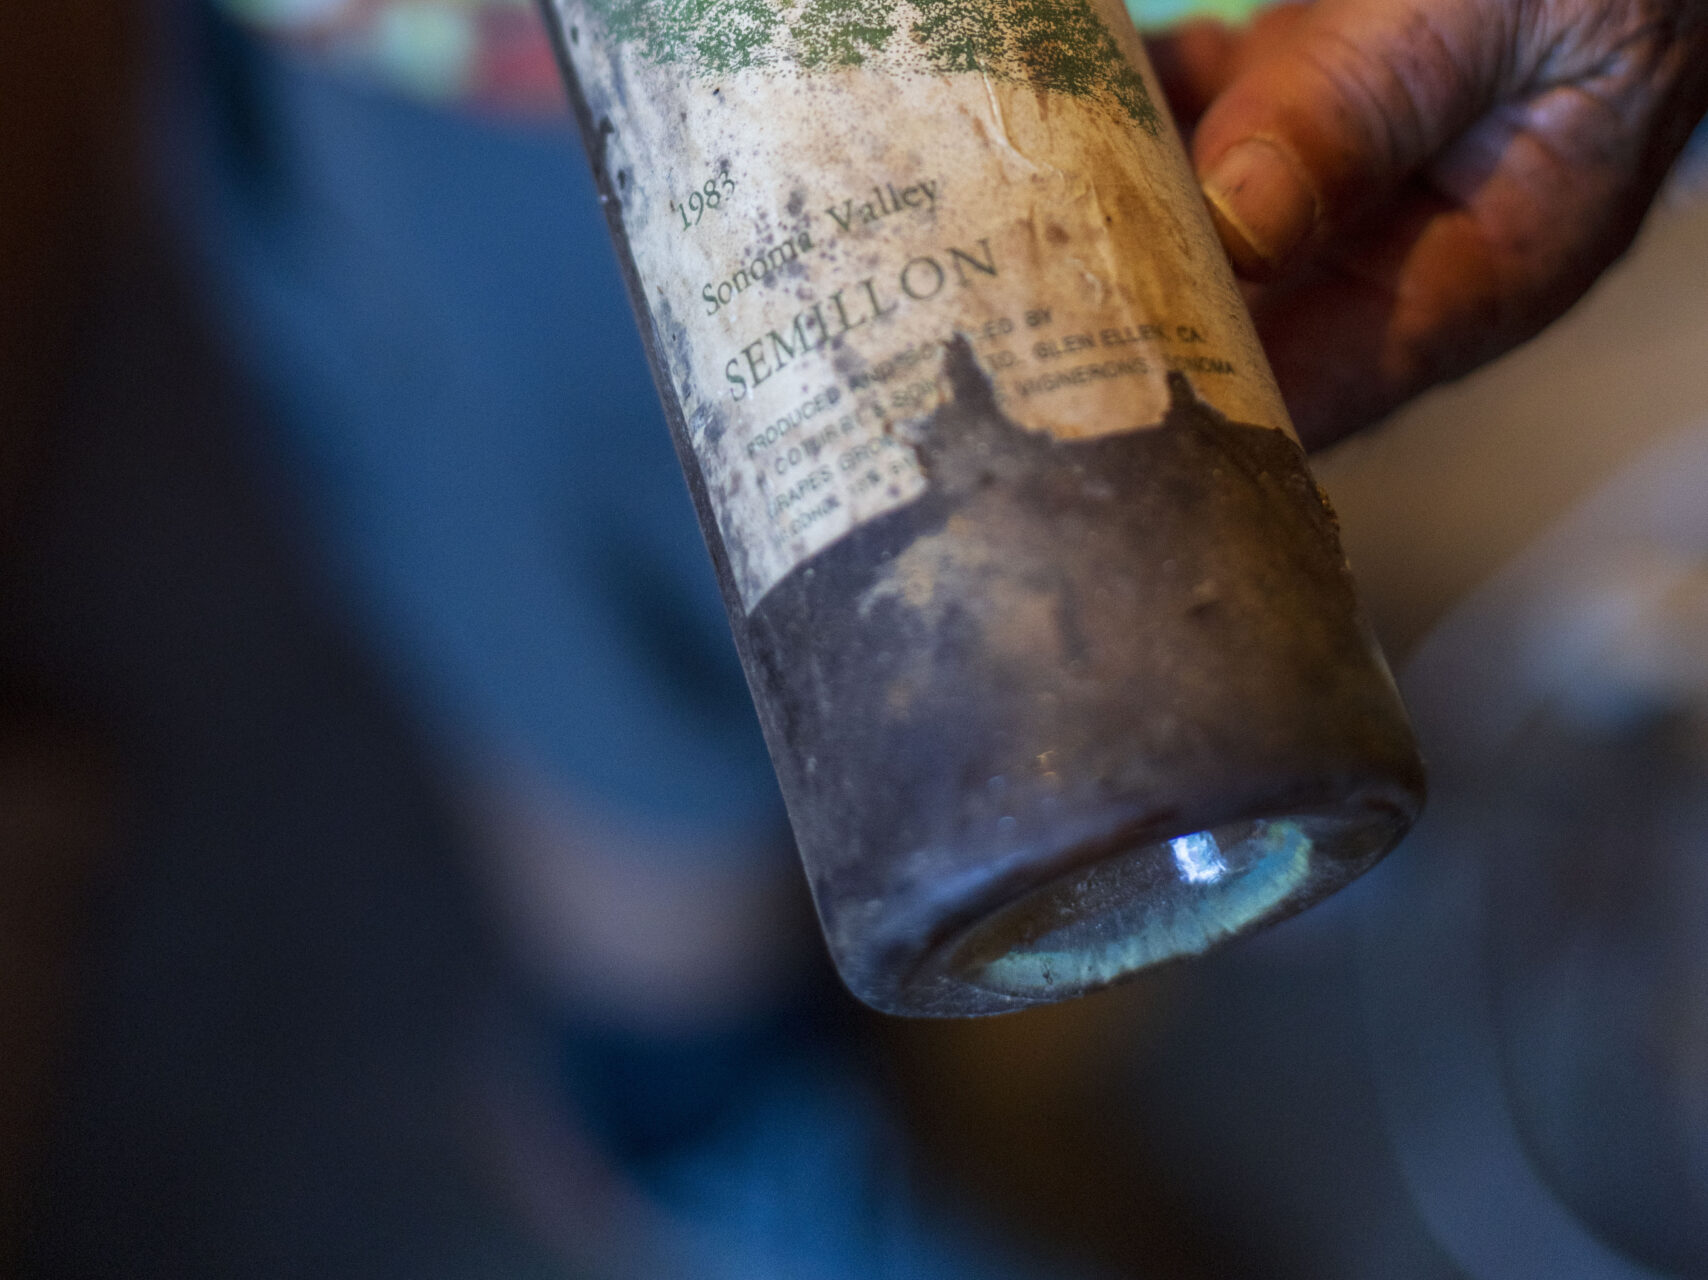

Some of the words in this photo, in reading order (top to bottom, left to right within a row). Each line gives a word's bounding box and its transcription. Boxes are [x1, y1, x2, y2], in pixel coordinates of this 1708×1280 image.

[677, 169, 735, 232] 1983
[702, 231, 815, 317] Sonoma
[826, 179, 938, 232] Valley
[725, 237, 998, 402] SEMILLON
